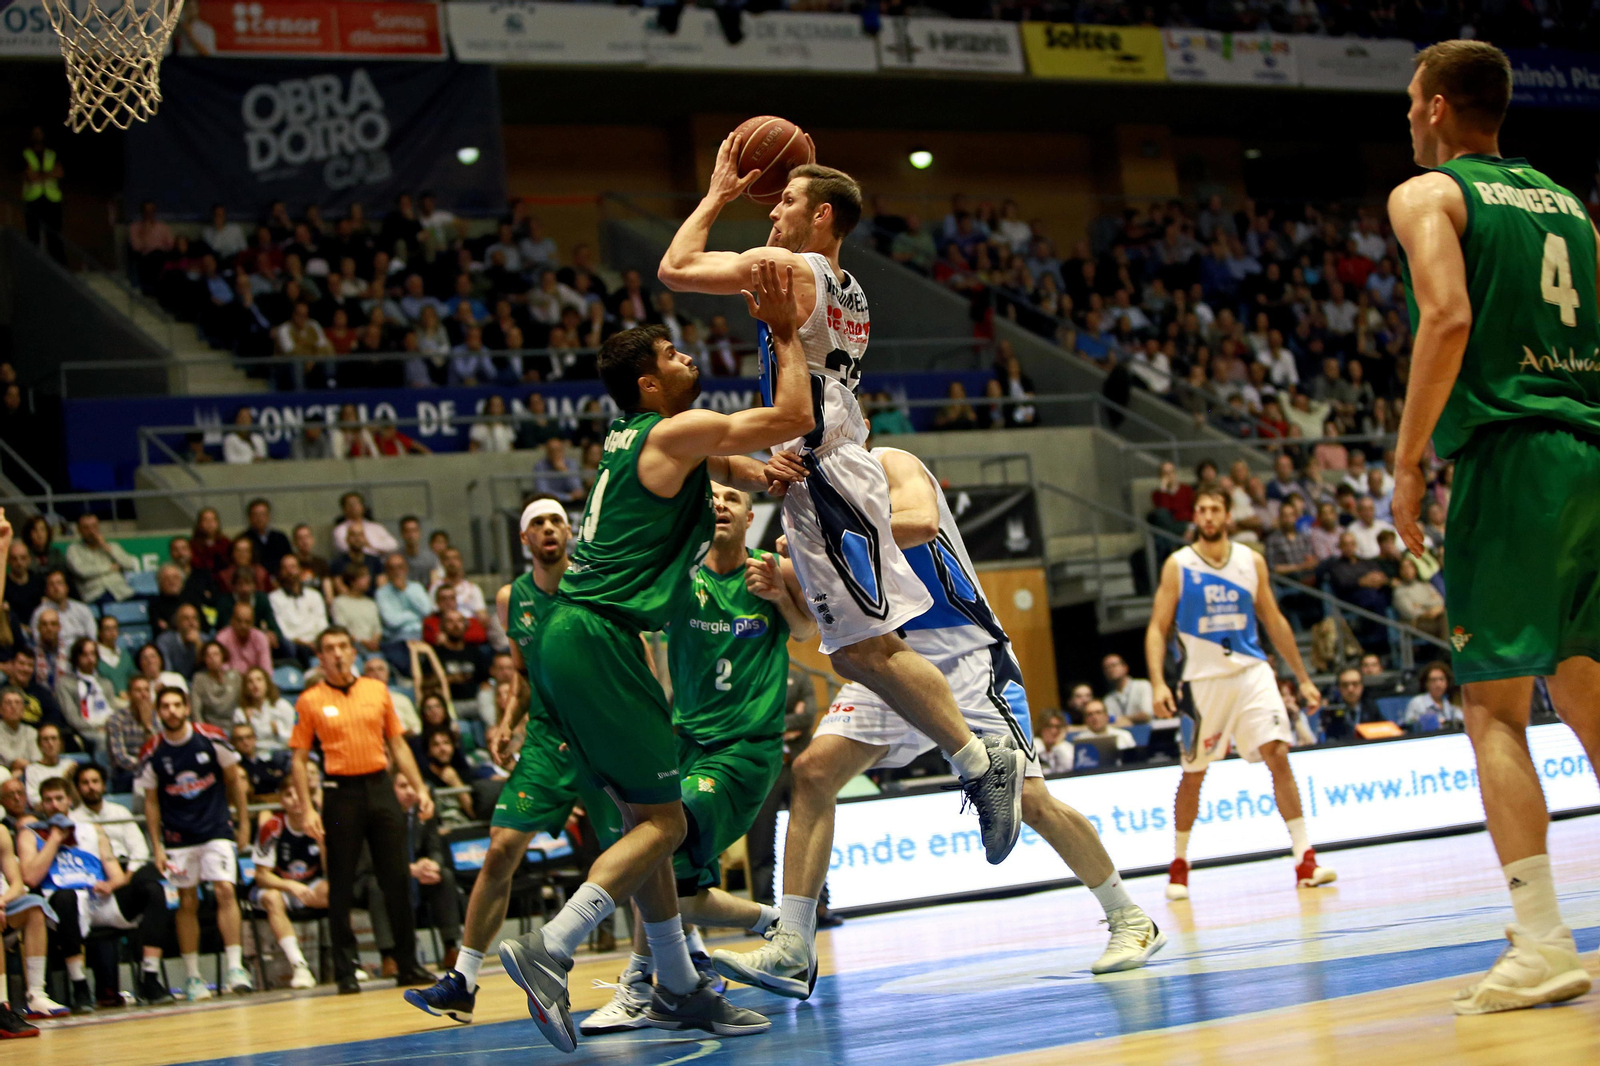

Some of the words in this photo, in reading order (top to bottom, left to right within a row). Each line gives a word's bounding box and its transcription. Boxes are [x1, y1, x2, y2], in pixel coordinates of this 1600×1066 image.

[242, 67, 386, 130] OBRA
[1512, 62, 1568, 89] mino's
[243, 111, 392, 172] DOIRO
[1540, 231, 1580, 328] 4
[416, 399, 459, 436] DE
[715, 657, 733, 692] 2
[828, 833, 916, 870] onde
[1111, 805, 1168, 833] tus
[1197, 789, 1276, 824] ueño
